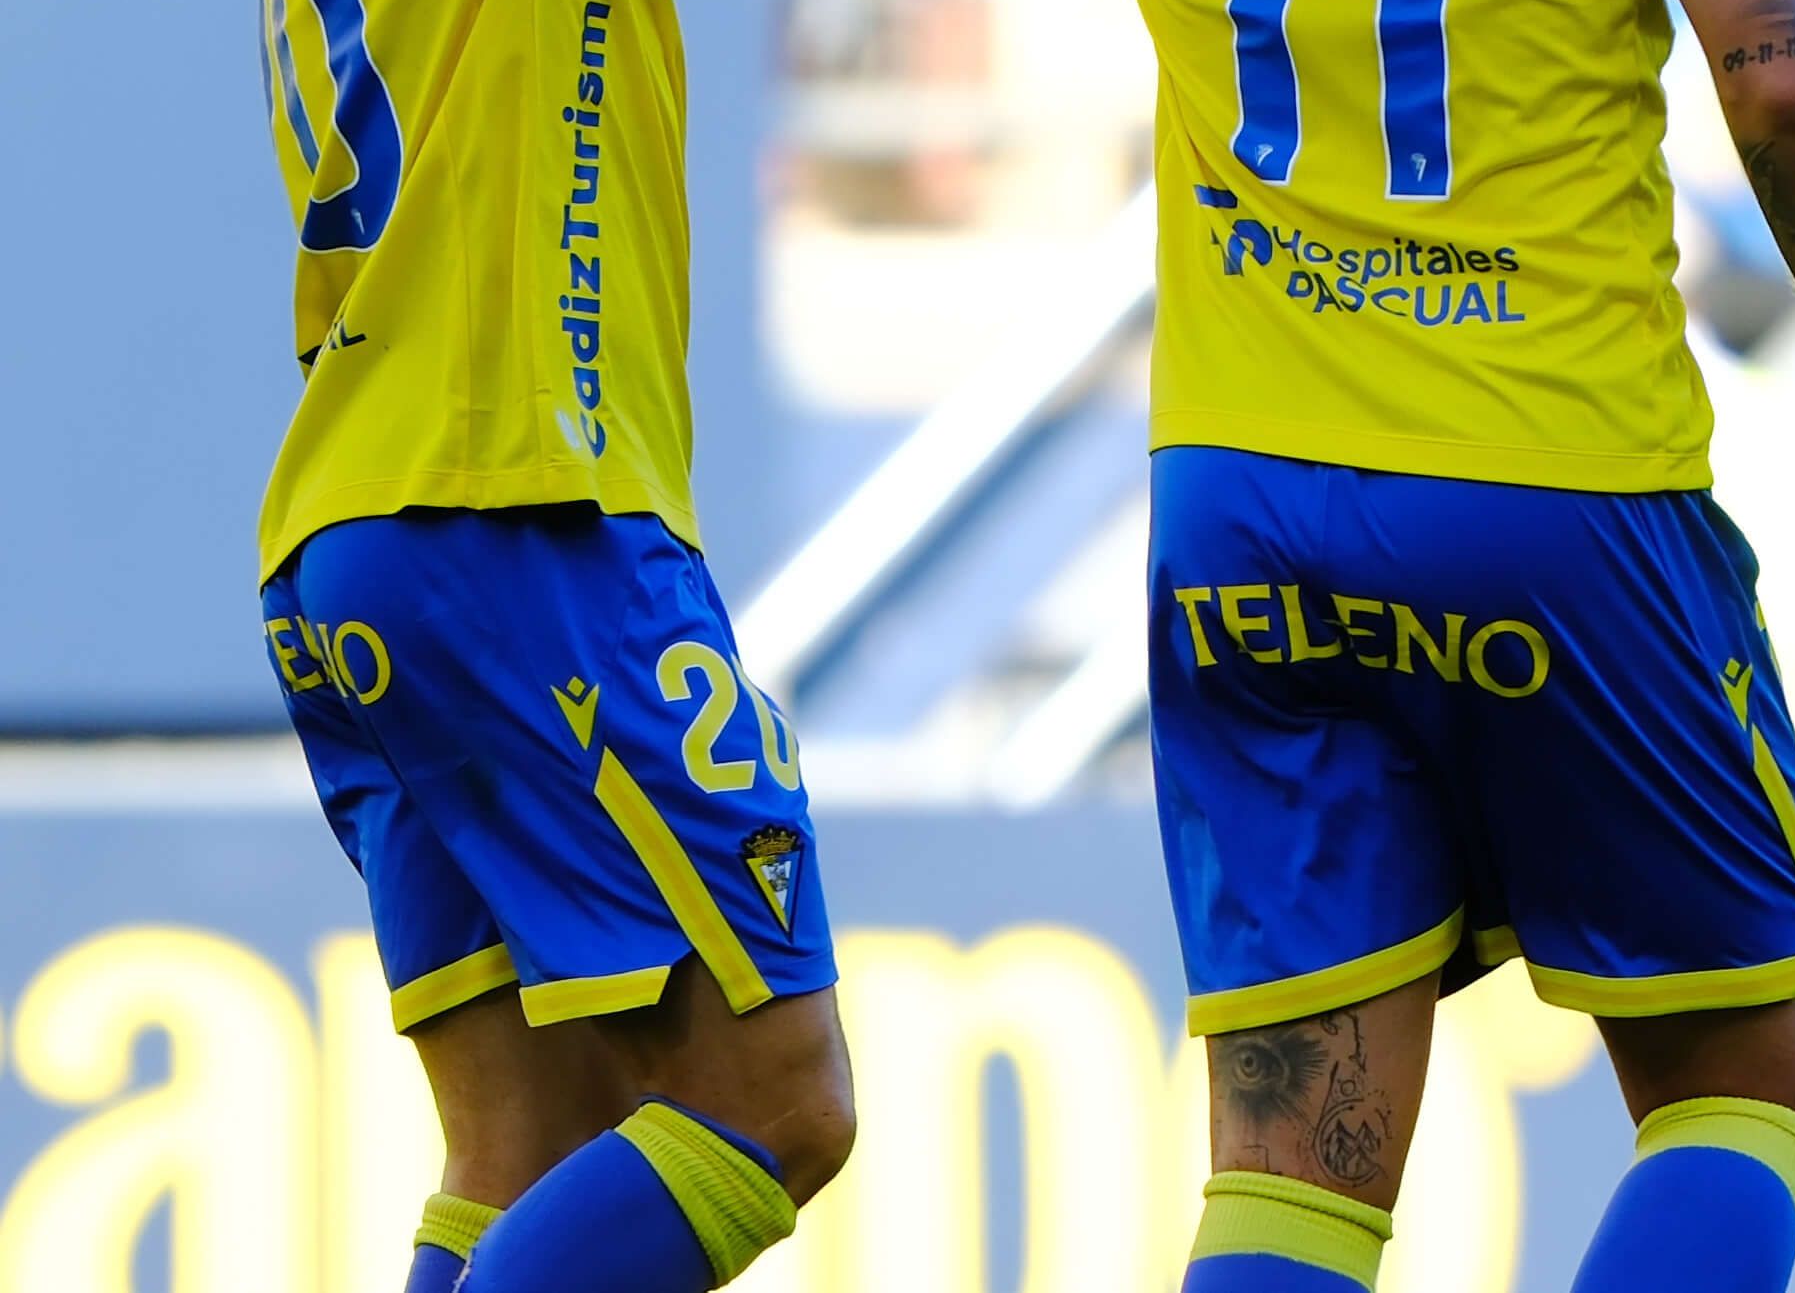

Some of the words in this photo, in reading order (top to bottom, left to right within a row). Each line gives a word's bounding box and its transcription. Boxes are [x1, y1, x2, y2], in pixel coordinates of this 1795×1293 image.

[1273, 226, 1520, 285] Hospitales
[1286, 270, 1526, 327] PASCUAL
[264, 615, 391, 705] ENO
[1174, 584, 1551, 698] TELENO
[656, 641, 800, 794] 20
